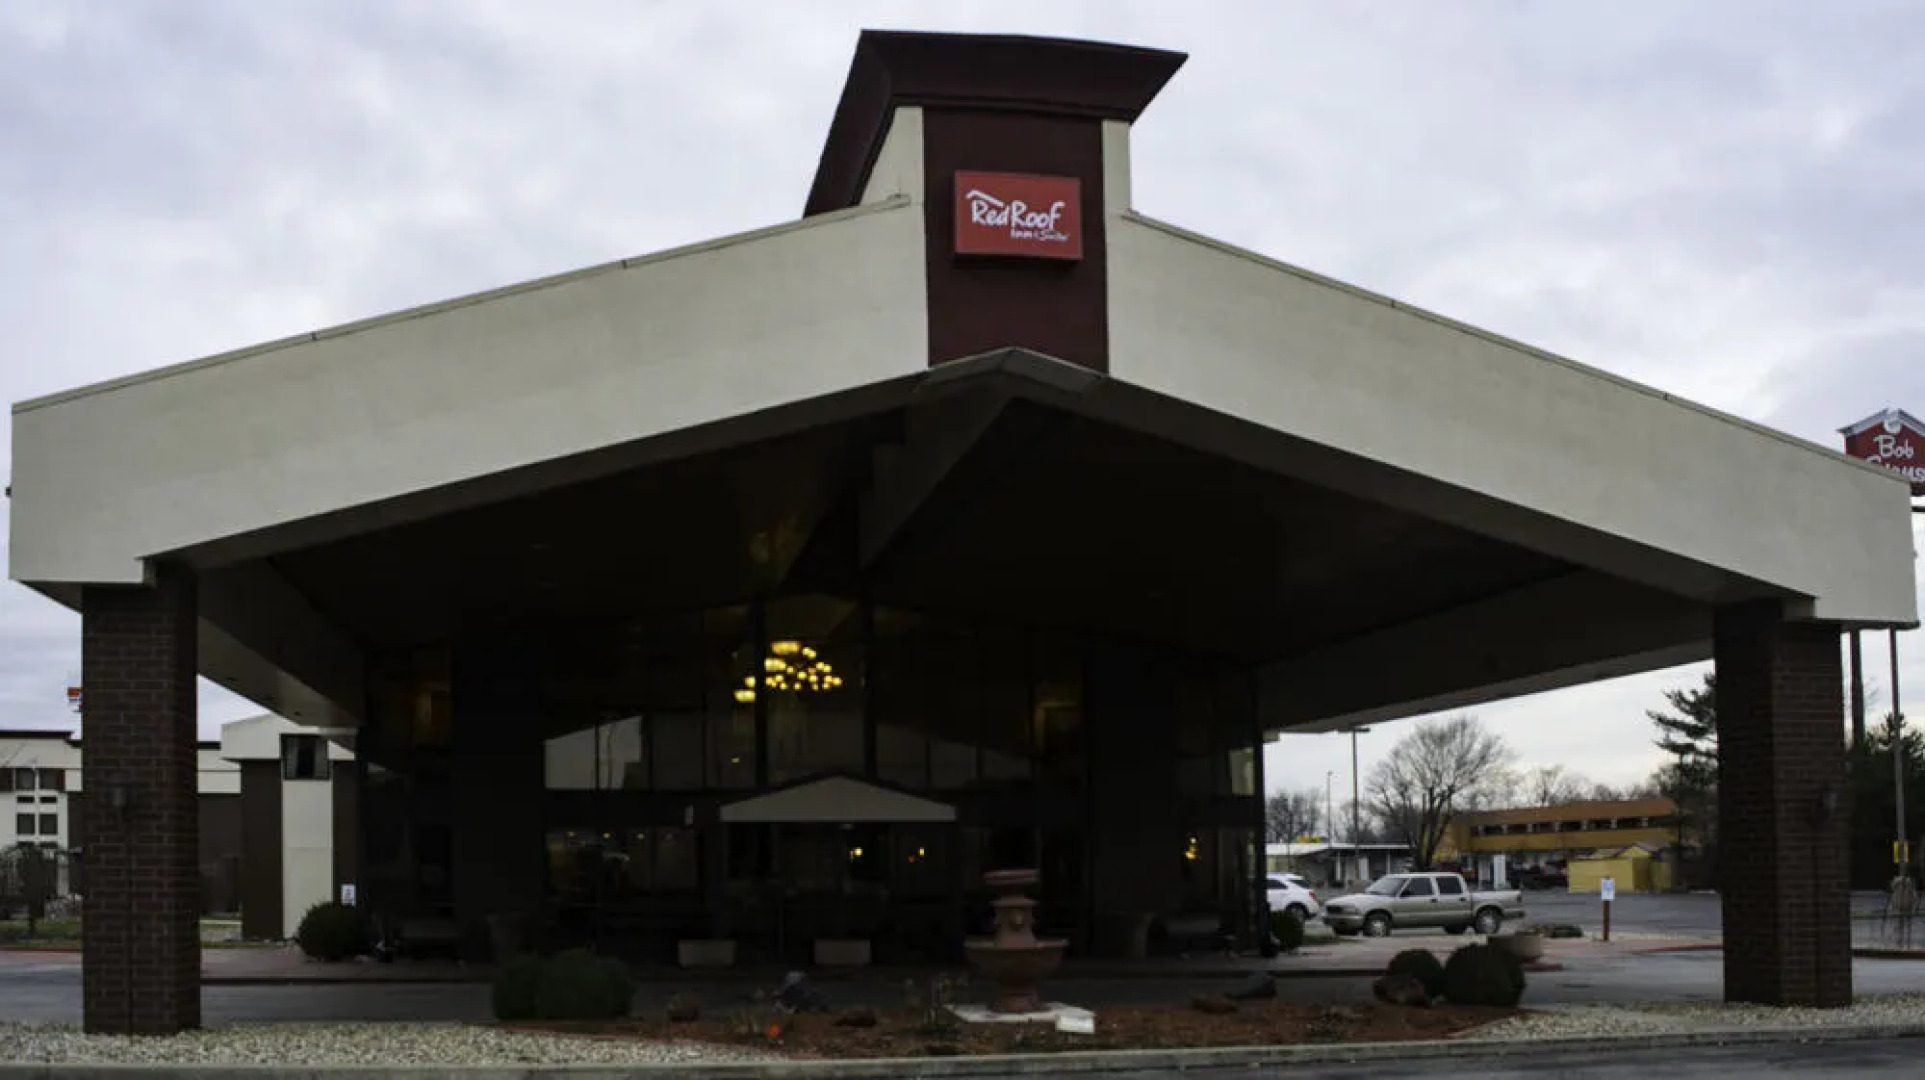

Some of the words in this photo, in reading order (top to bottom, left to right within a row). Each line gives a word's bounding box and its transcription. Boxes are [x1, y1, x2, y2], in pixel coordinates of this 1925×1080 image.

[971, 199, 1010, 226] Red
[1010, 200, 1065, 230] Roof
[1873, 434, 1914, 458] Bob
